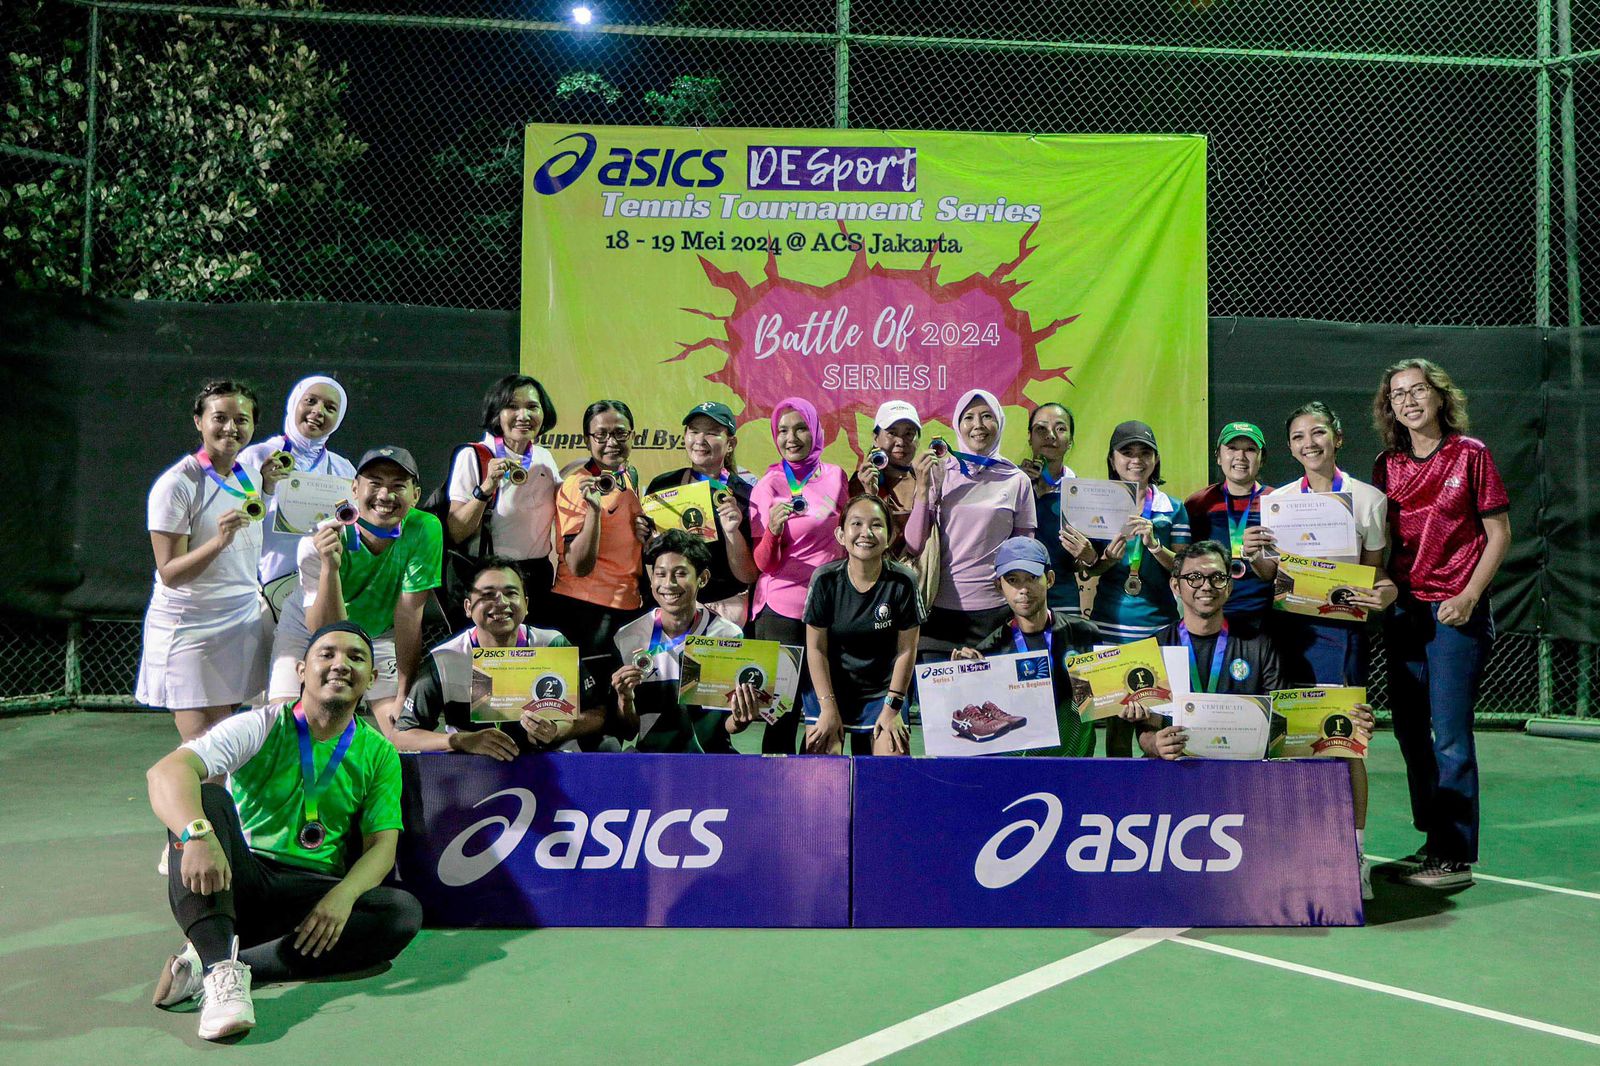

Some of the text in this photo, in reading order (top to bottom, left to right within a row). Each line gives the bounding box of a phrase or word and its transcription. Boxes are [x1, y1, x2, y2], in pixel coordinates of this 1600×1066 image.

[750, 147, 917, 192] DE Sport
[601, 192, 1042, 223] Tennis Tournament Series
[605, 230, 630, 250] 18
[652, 234, 676, 253] 19
[681, 230, 726, 251] Mei
[731, 235, 782, 255] 2024
[787, 232, 807, 251] @
[812, 232, 864, 252] ACS
[868, 233, 963, 254] Jakarta
[754, 304, 1000, 360] Battle Of 2024
[822, 364, 931, 390] SERIES
[535, 701, 562, 709] WINNER
